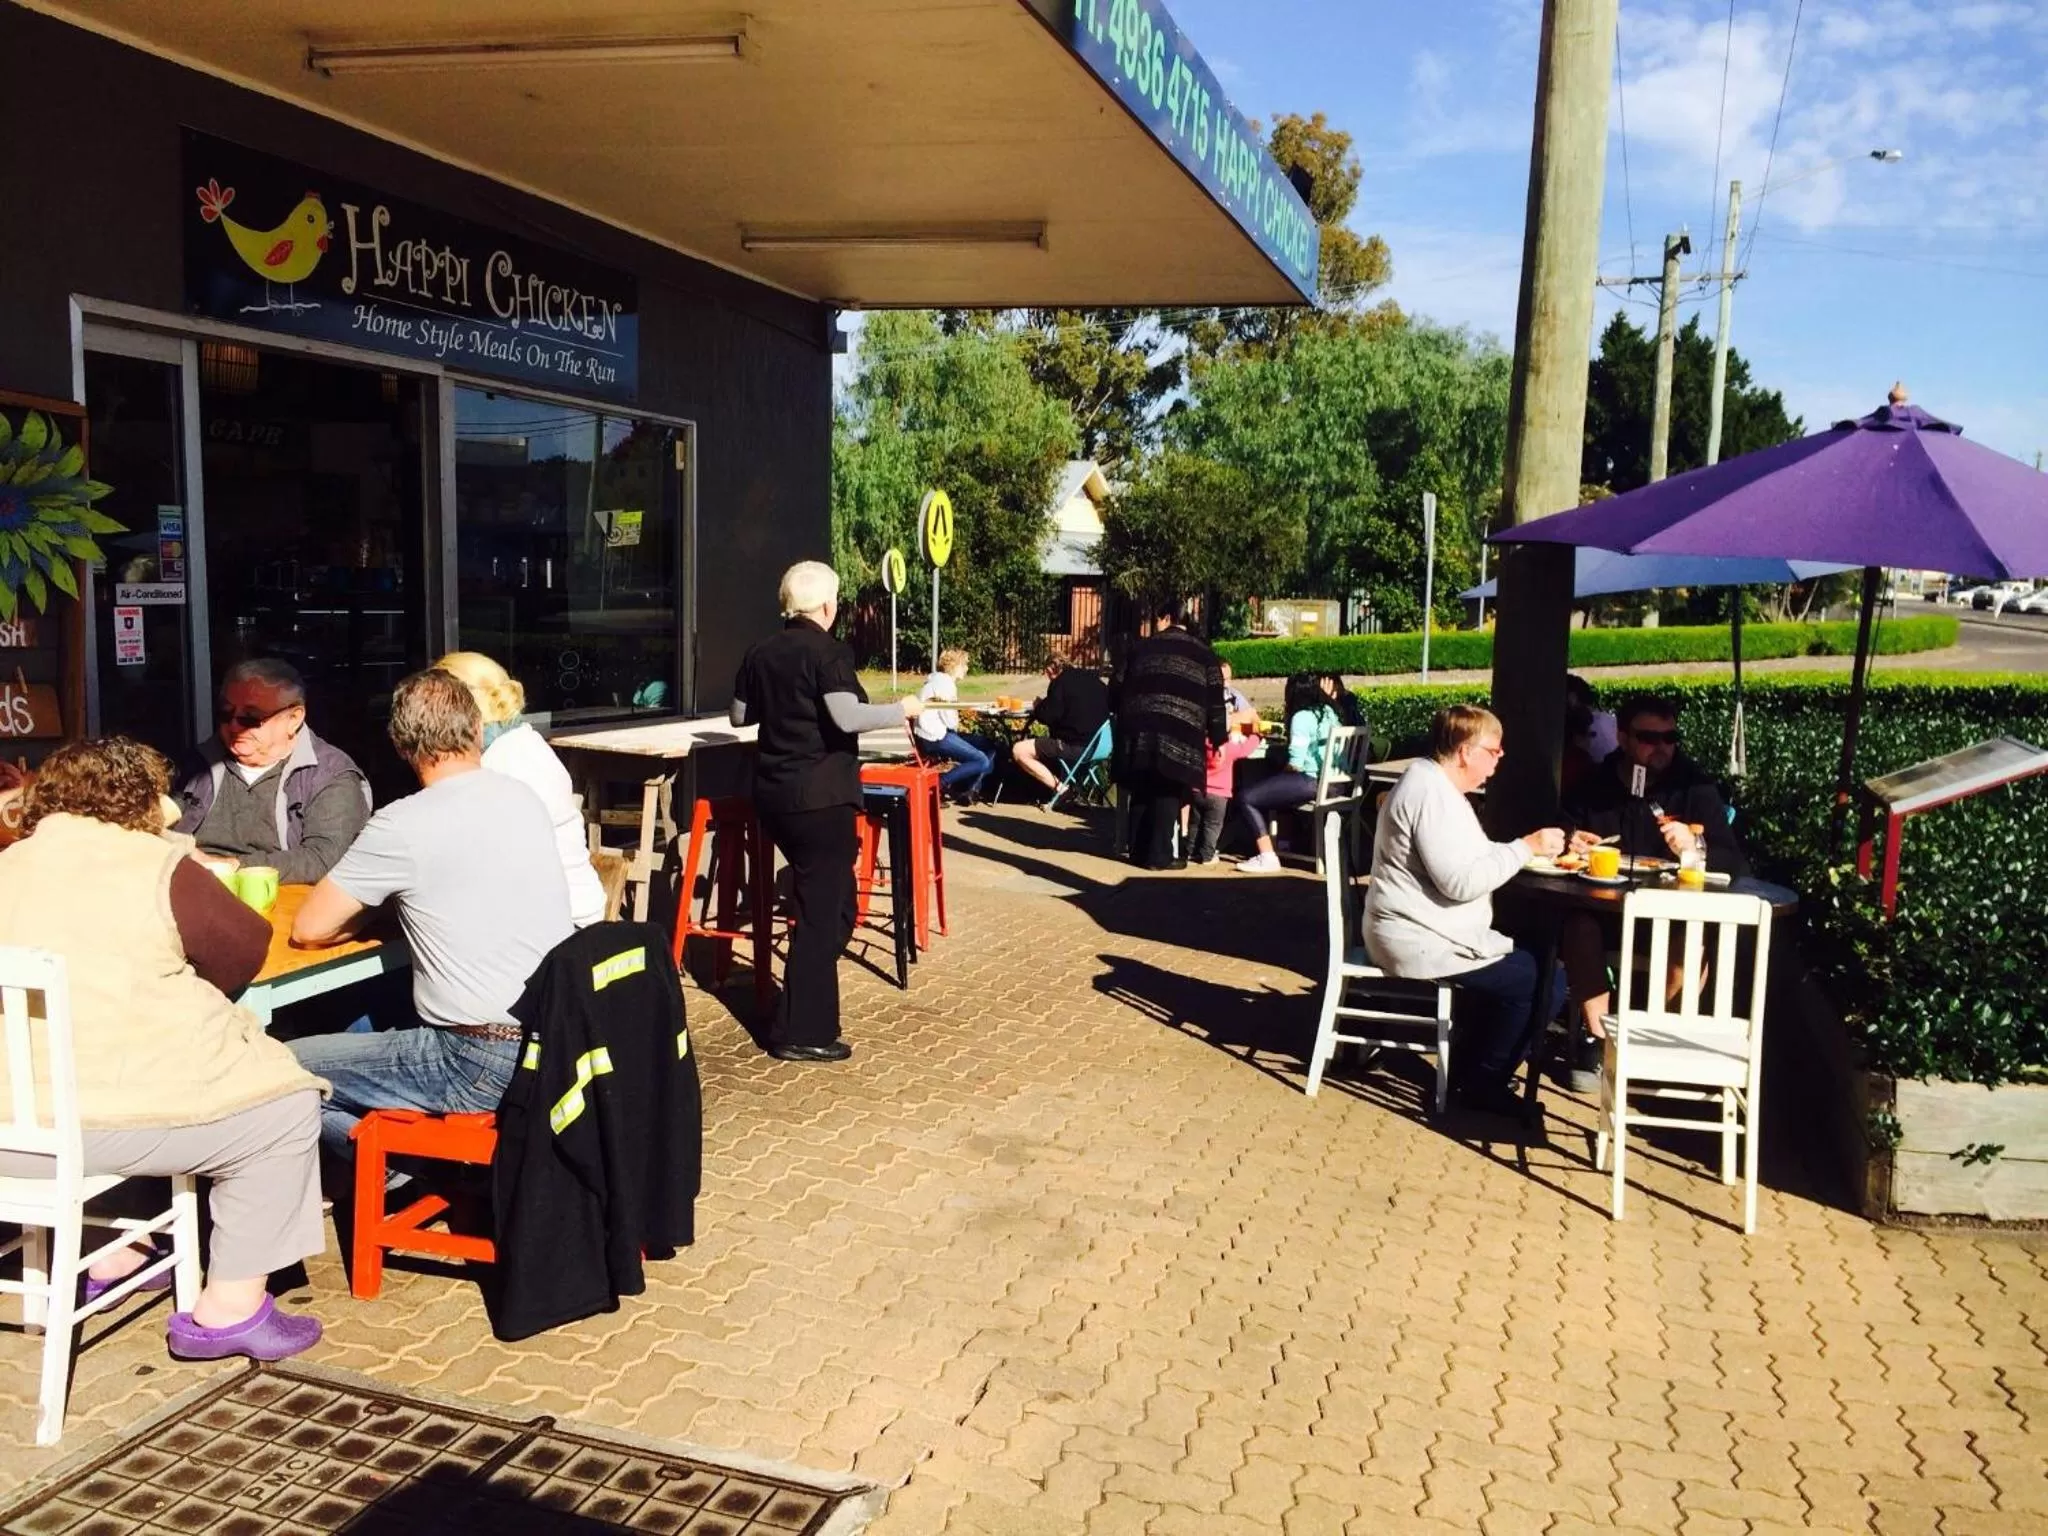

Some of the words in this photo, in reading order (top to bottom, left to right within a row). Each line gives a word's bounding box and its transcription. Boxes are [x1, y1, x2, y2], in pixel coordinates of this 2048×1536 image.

[1109, 0, 1165, 110] 4936
[1167, 54, 1211, 161] 4715
[485, 250, 623, 344] CHICKEN
[352, 303, 412, 339] Home
[415, 318, 464, 358] Style
[468, 329, 522, 363] Meals
[526, 344, 549, 369] On
[554, 350, 582, 377] The
[585, 356, 616, 385] Run
[120, 588, 183, 599] Air-Conditioned
[241, 1459, 310, 1501] PMC
